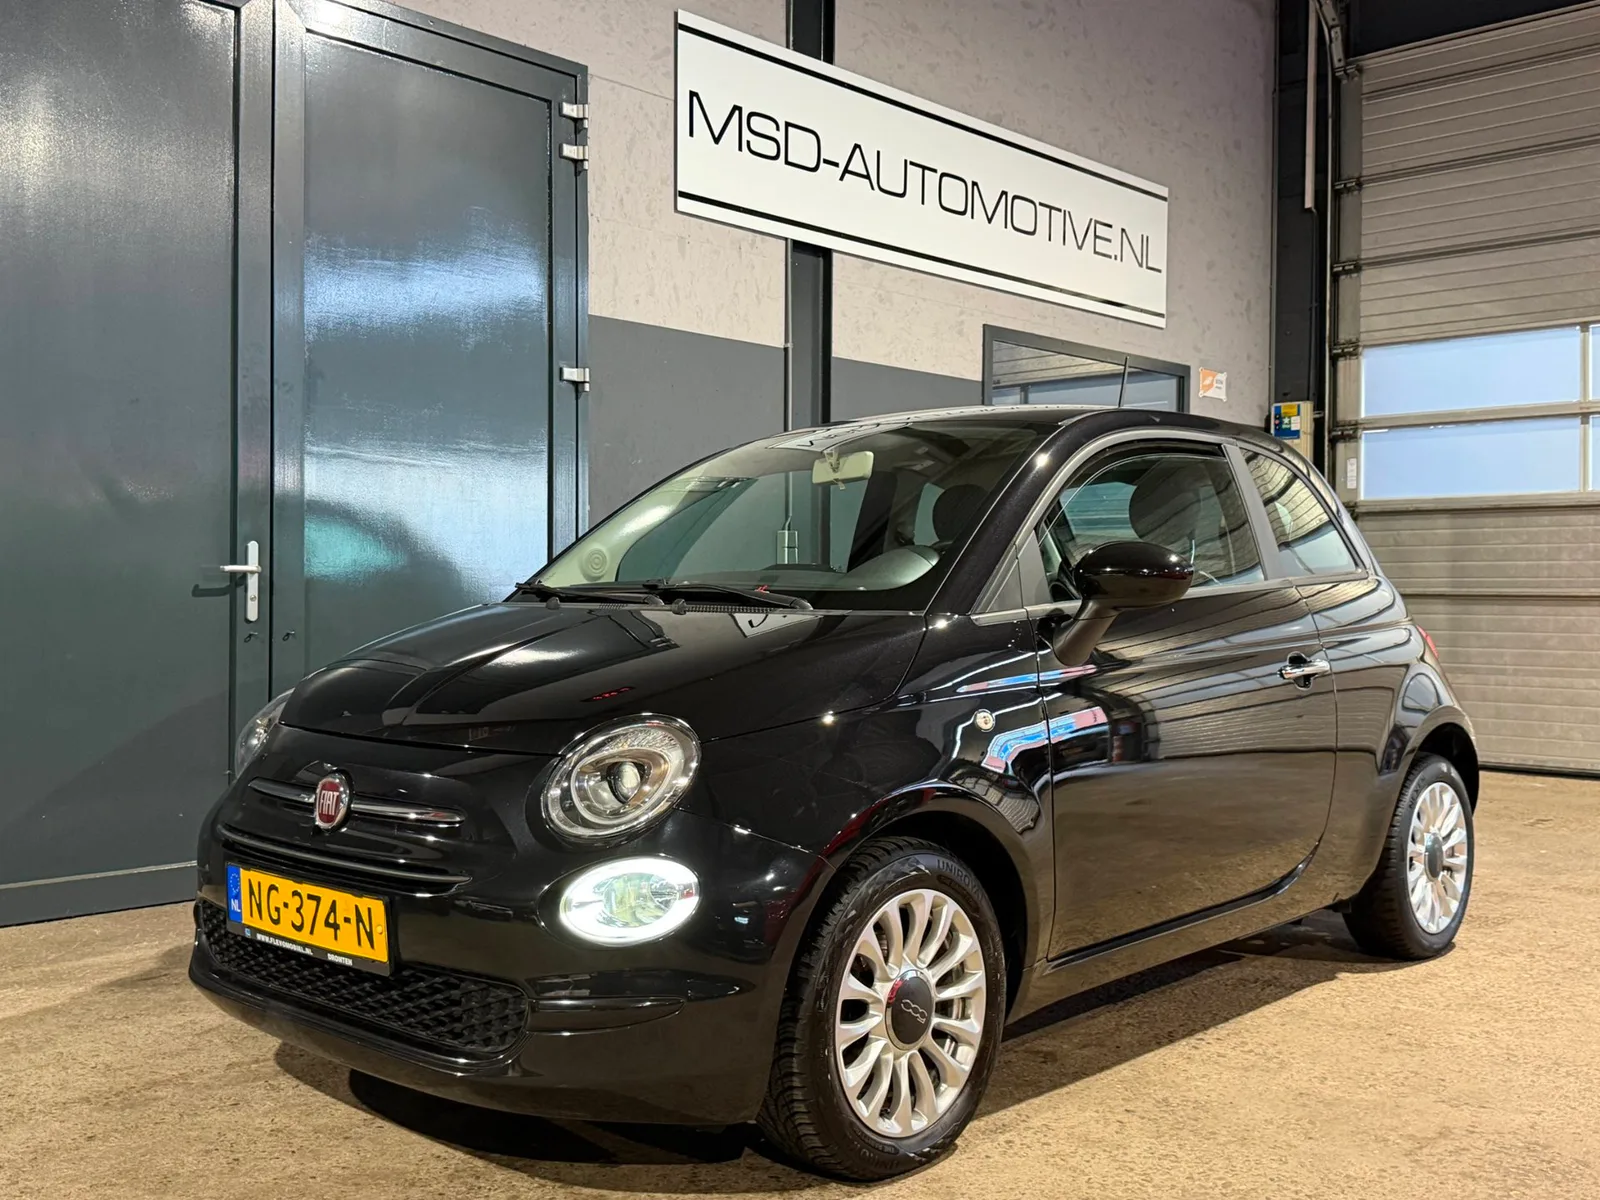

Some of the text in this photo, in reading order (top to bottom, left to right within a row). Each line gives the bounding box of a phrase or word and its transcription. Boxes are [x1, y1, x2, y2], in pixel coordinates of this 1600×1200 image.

[688, 89, 1163, 274] MSD-AUTOMOTIVE.NL
[319, 789, 340, 816] FIAT
[230, 898, 242, 912] NL
[248, 877, 375, 950] NG-374-N
